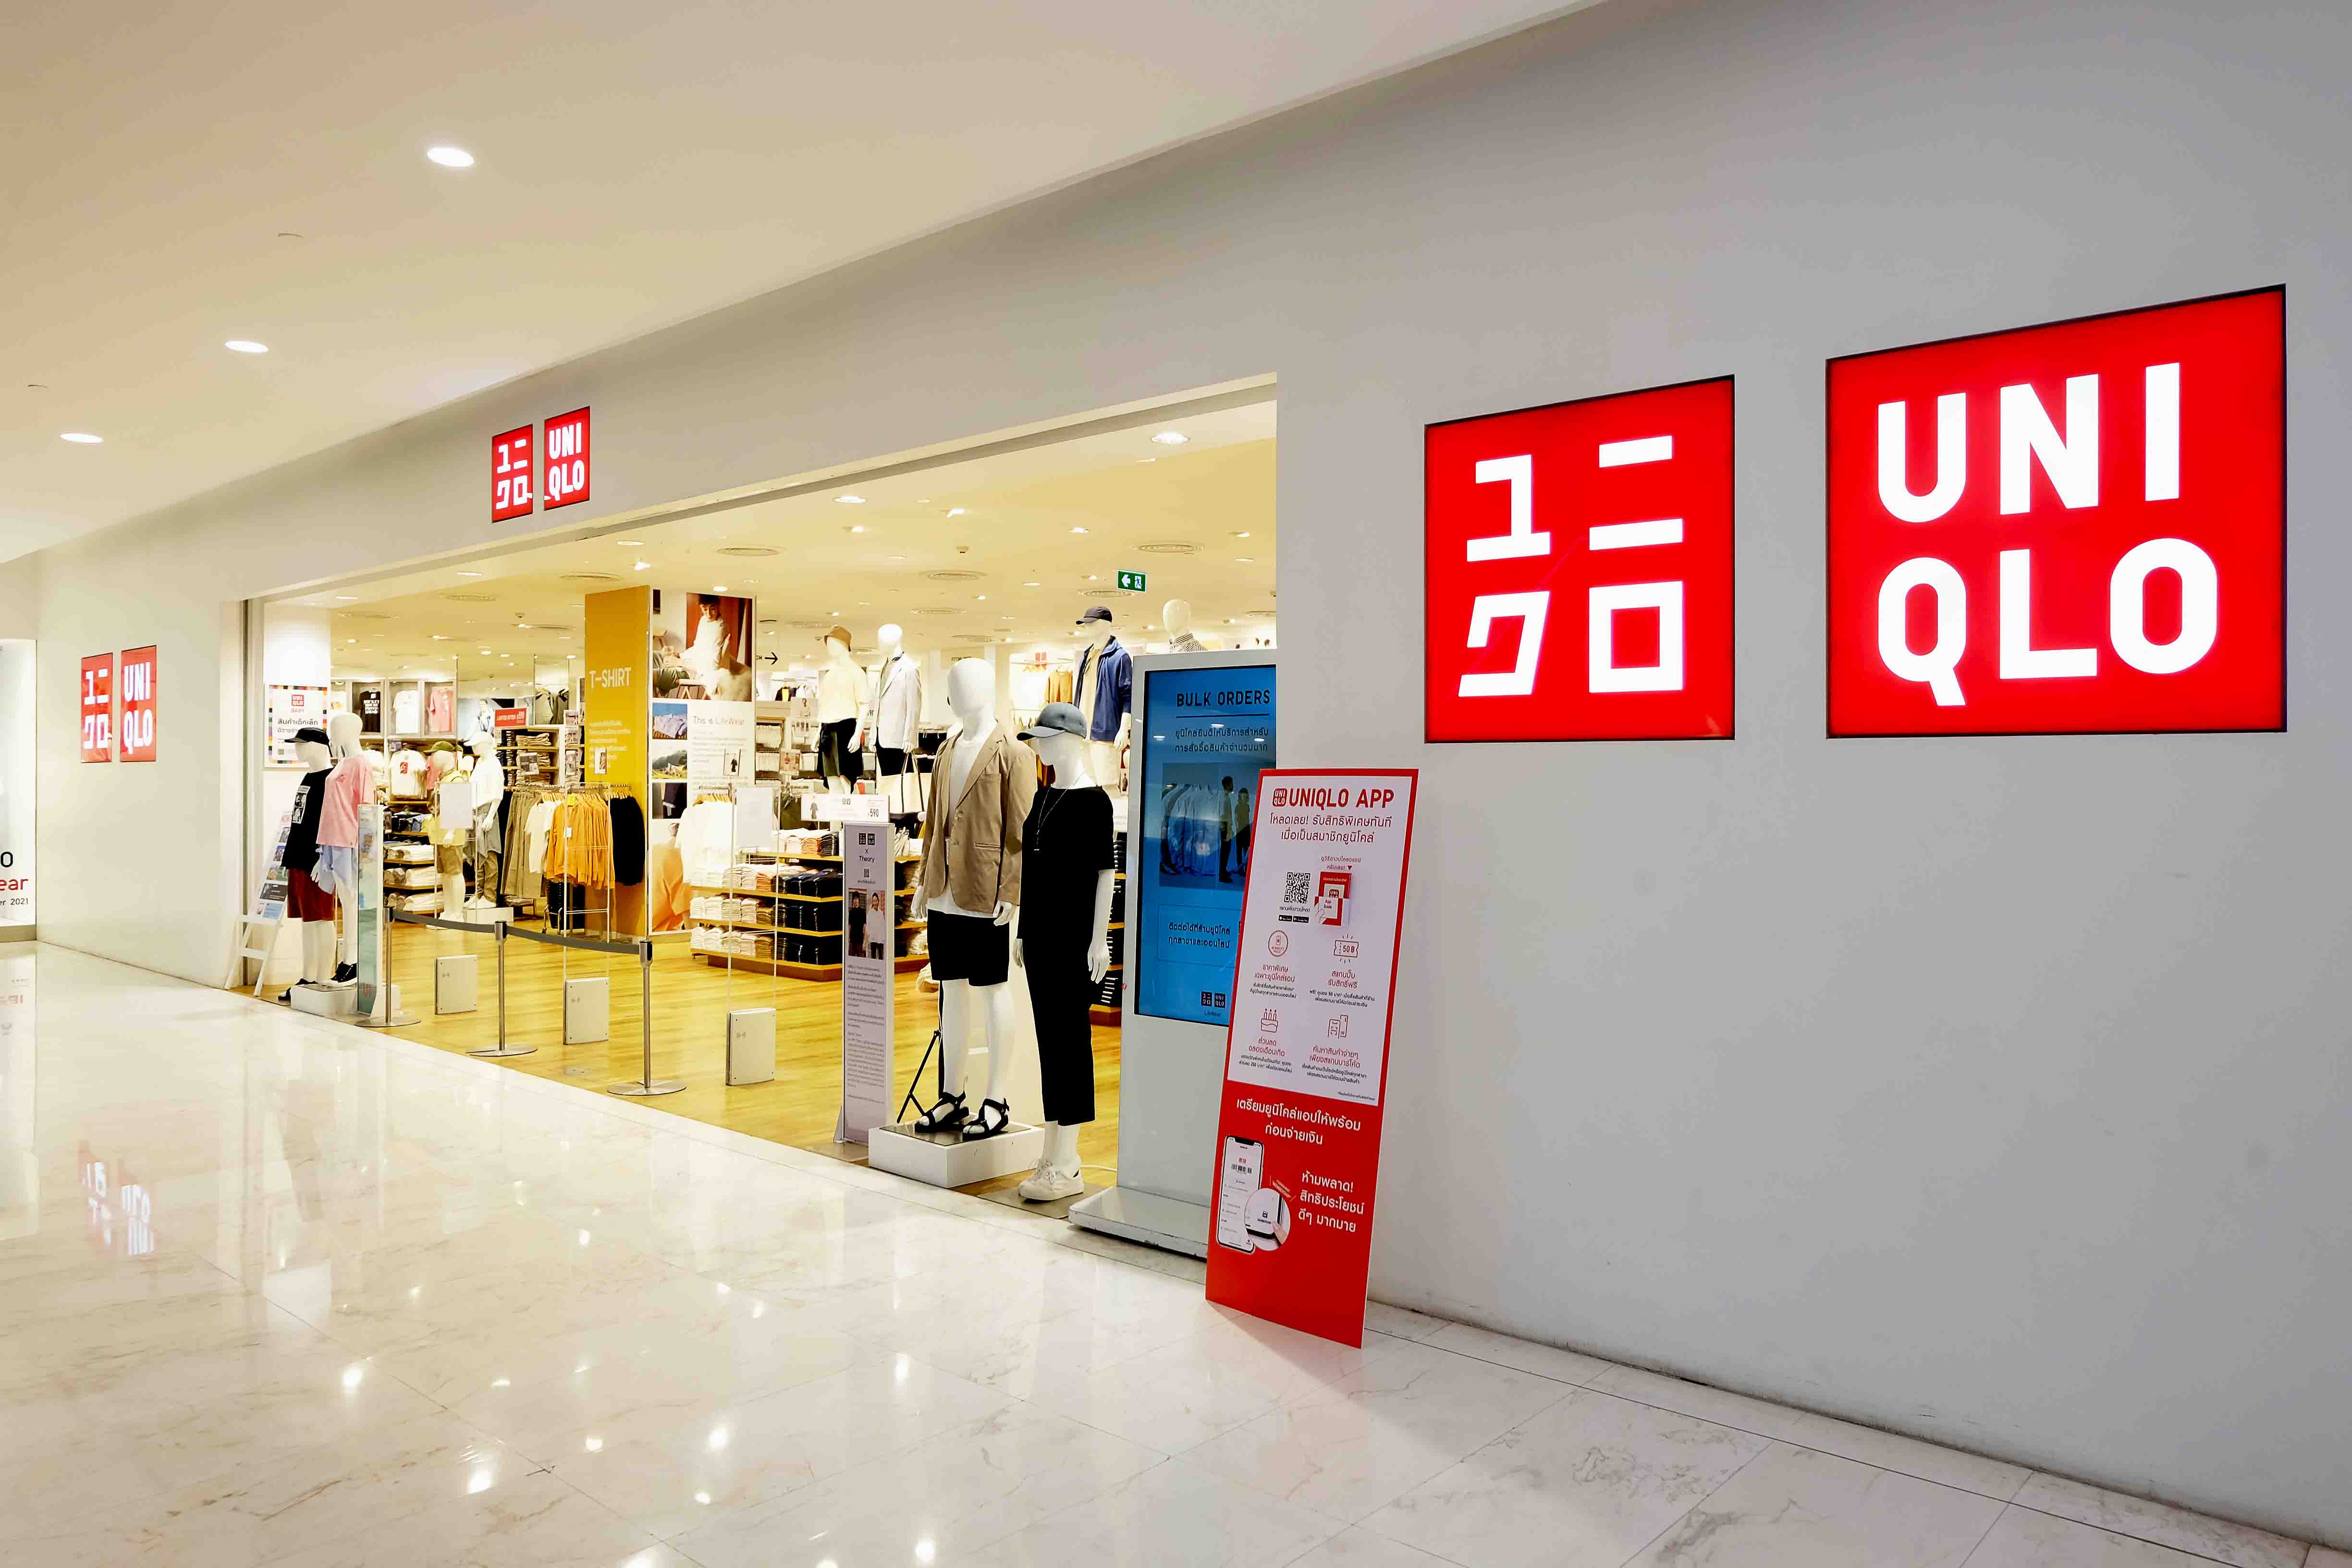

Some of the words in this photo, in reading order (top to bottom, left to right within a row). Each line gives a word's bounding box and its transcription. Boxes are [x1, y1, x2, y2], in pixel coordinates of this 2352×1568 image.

[497, 439, 527, 474] ユニ
[549, 422, 582, 459] UNI
[1878, 362, 2180, 523] UNI
[496, 475, 527, 510] クロ
[549, 460, 585, 501] QLO
[1467, 435, 1683, 563] ユニ
[1458, 580, 1683, 697] クロ
[1878, 538, 2218, 705] QLO
[85, 669, 109, 705] ユニ
[124, 662, 150, 701] UNI
[589, 667, 630, 688] T-SHIRT
[1176, 692, 1211, 707] BULK
[1218, 689, 1271, 706] ORDERS
[84, 714, 109, 749] クロ
[124, 709, 153, 754] QLO
[1289, 788, 1349, 810] UNIQLO
[1356, 789, 1394, 808] APP
[1270, 812, 1309, 825] โหลดเลย!
[1281, 827, 1374, 845] เมื่อเป็นสมาชิกยูนิโคล่
[1237, 1098, 1361, 1131] เตรียมยูนิโคล่แอปให้พร้อม
[1265, 1122, 1323, 1145] ก่อนจ่ายเงิน
[1302, 1170, 1353, 1193] ห้ามพลาด!
[1300, 1190, 1364, 1214] สิทธิประโยชน์
[1298, 1208, 1312, 1225] ดีๆ
[1317, 1214, 1356, 1232] มากมาย
